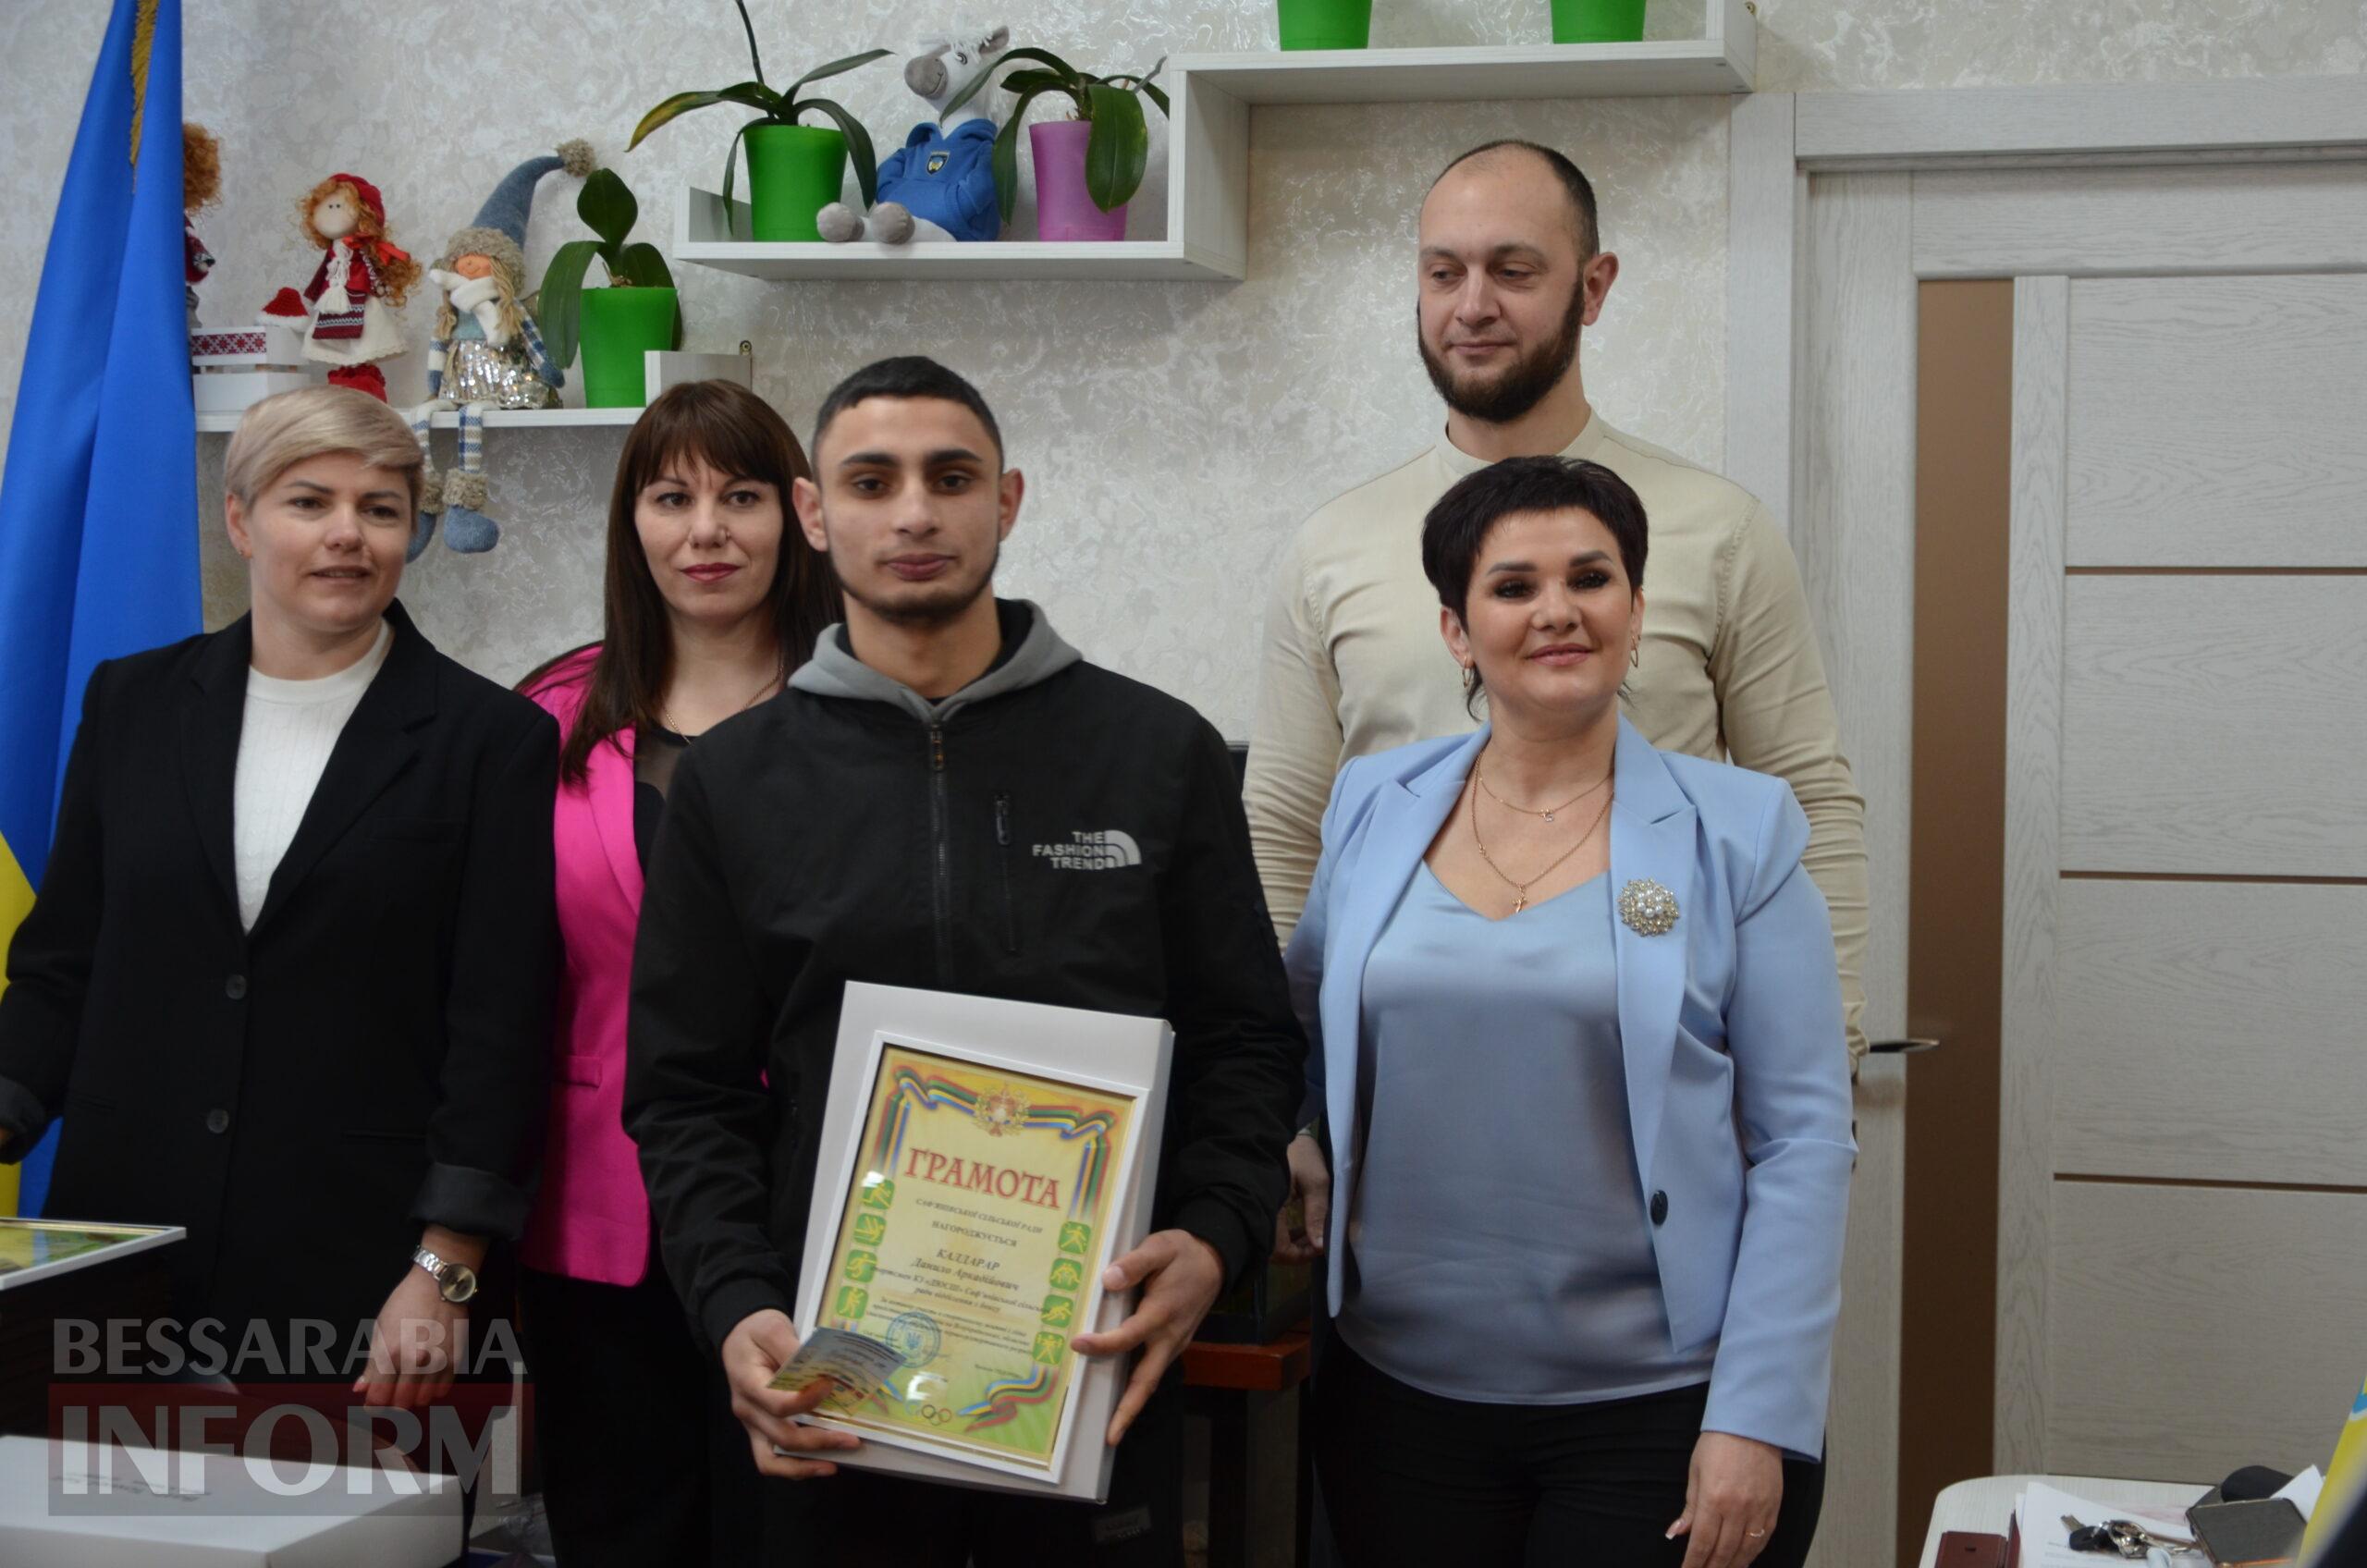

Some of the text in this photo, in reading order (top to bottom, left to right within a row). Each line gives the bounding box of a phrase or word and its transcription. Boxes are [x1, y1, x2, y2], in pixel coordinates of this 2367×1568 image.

[1072, 831, 1105, 843] THE
[1032, 844, 1105, 856] FASHION
[1050, 857, 1105, 870] TREND
[904, 1147, 1061, 1210] ГРАМОТА
